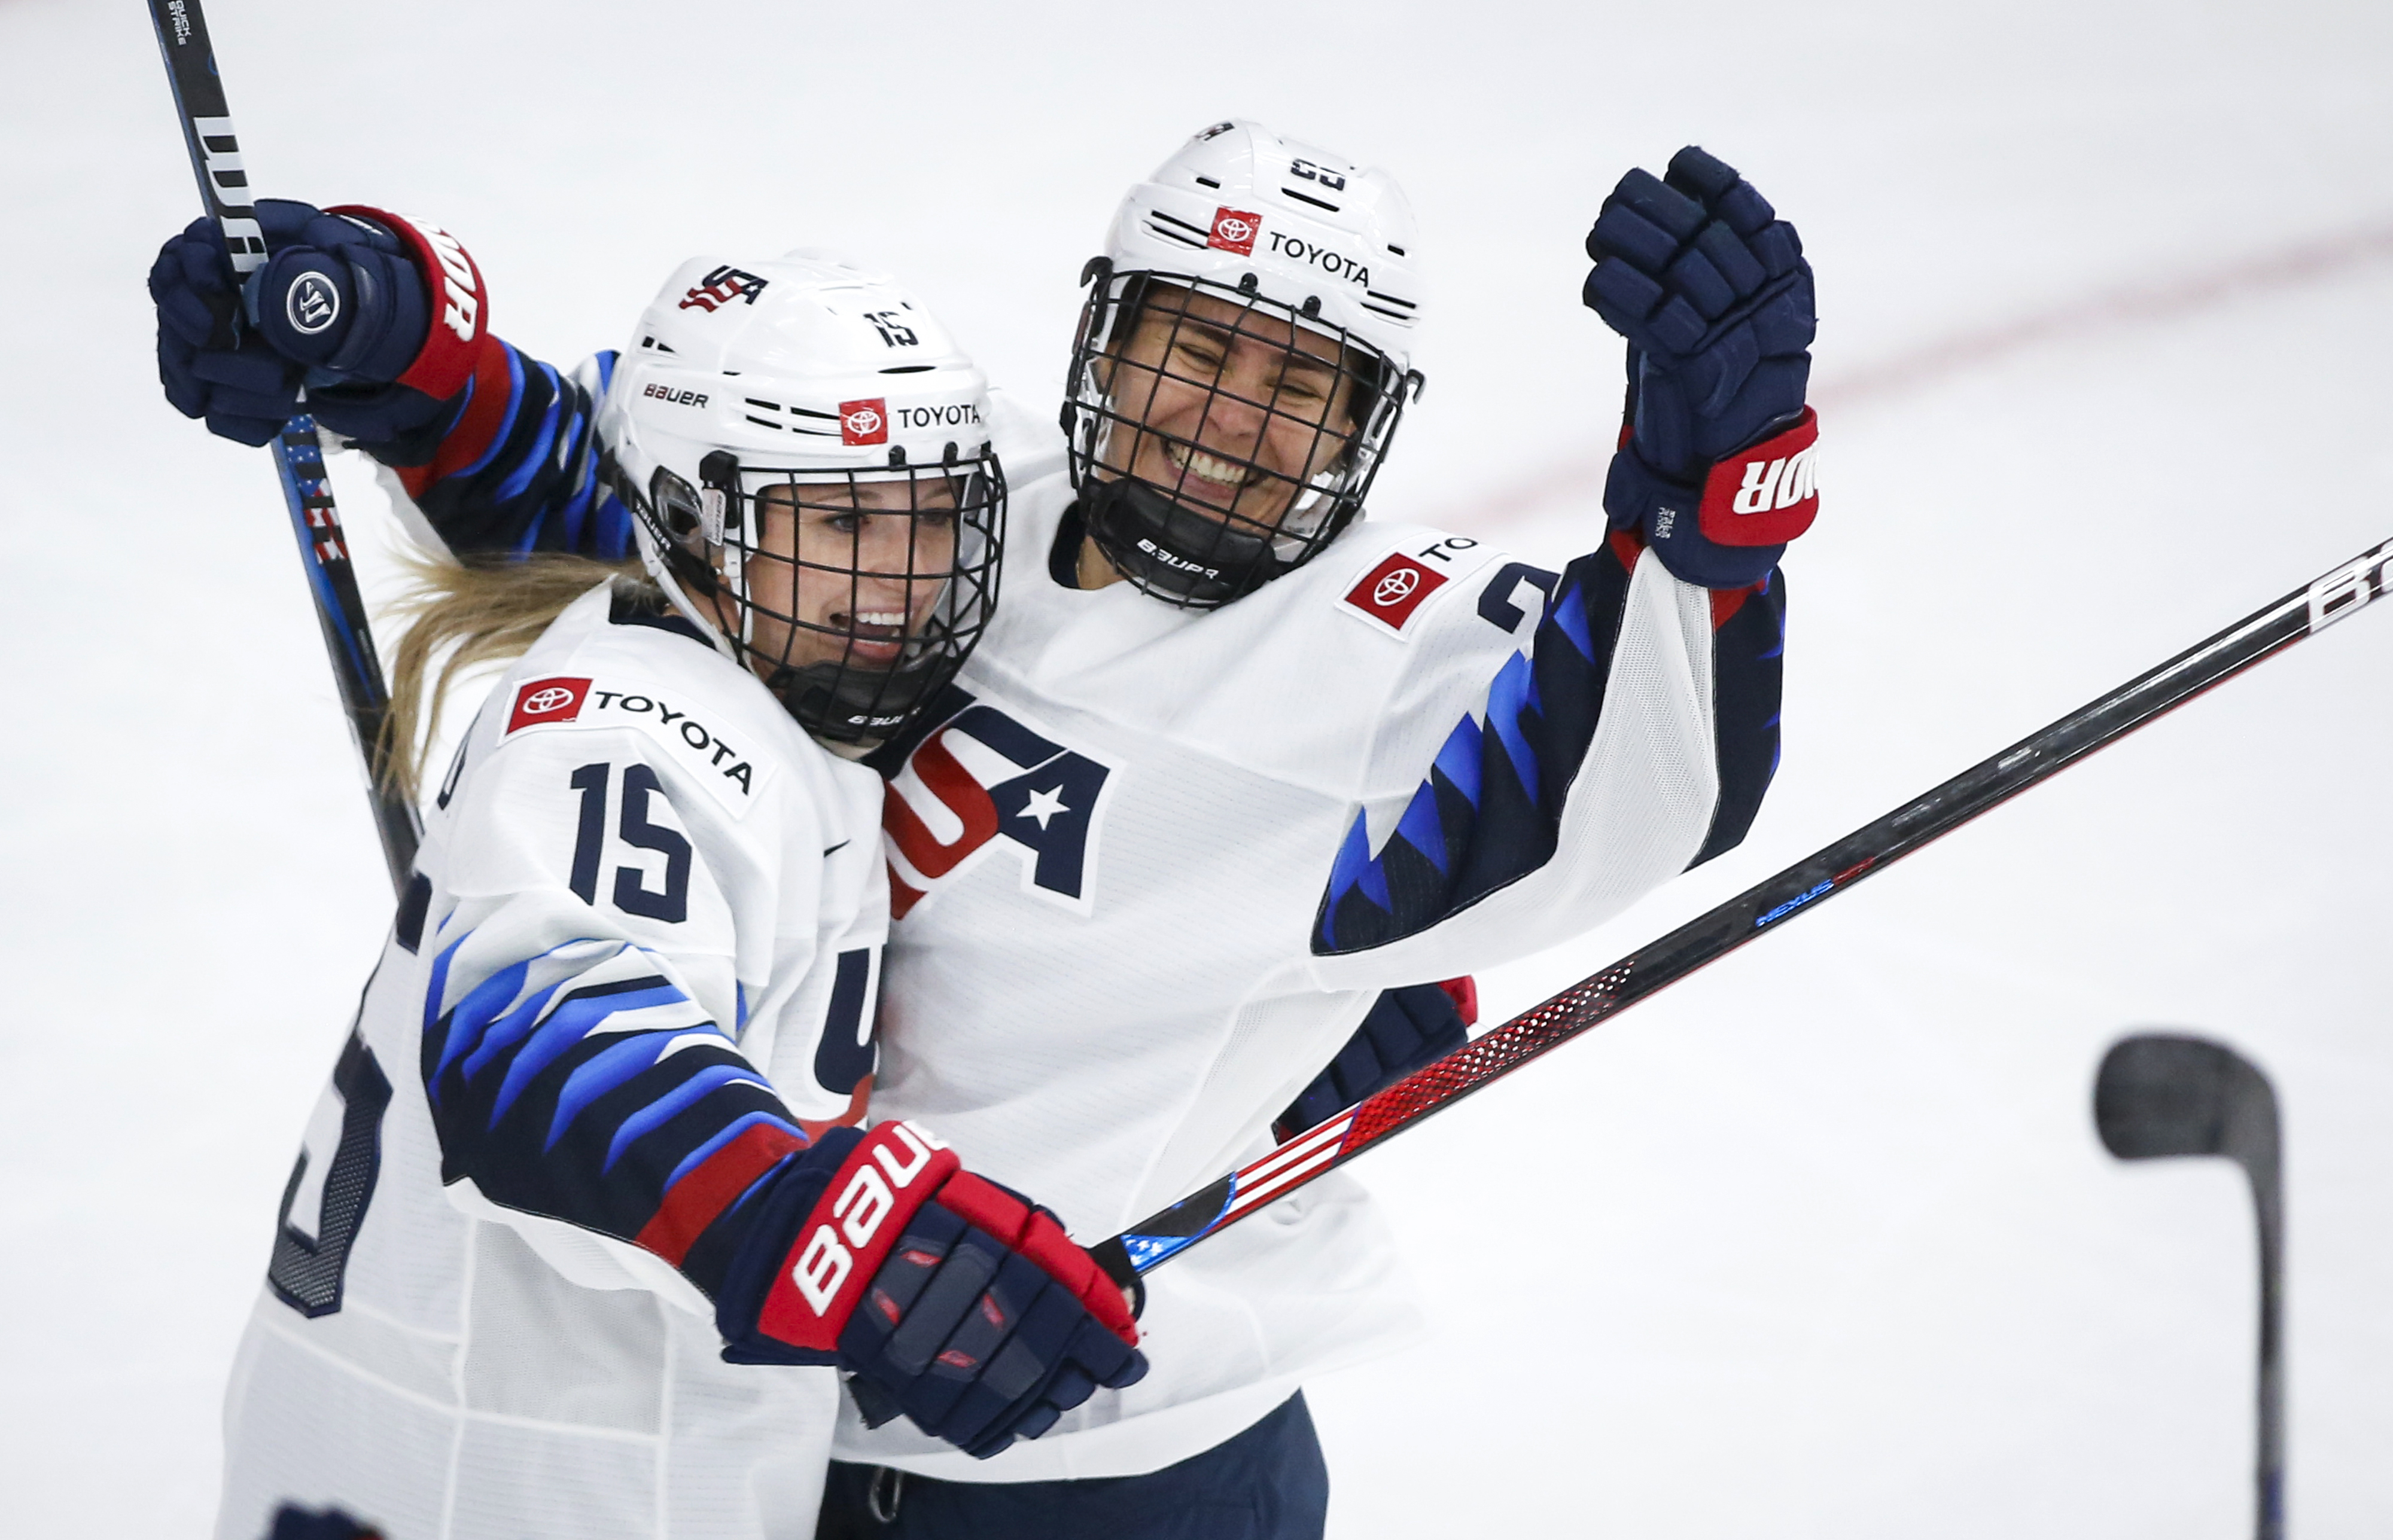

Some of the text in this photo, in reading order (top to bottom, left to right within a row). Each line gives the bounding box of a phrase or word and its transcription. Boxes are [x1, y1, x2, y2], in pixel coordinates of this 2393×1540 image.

[1270, 231, 1372, 288] TOYOTA
[863, 311, 919, 348] 15
[898, 404, 981, 428] TOYOTA
[595, 691, 753, 796] TOYOTA
[570, 762, 692, 924] 15
